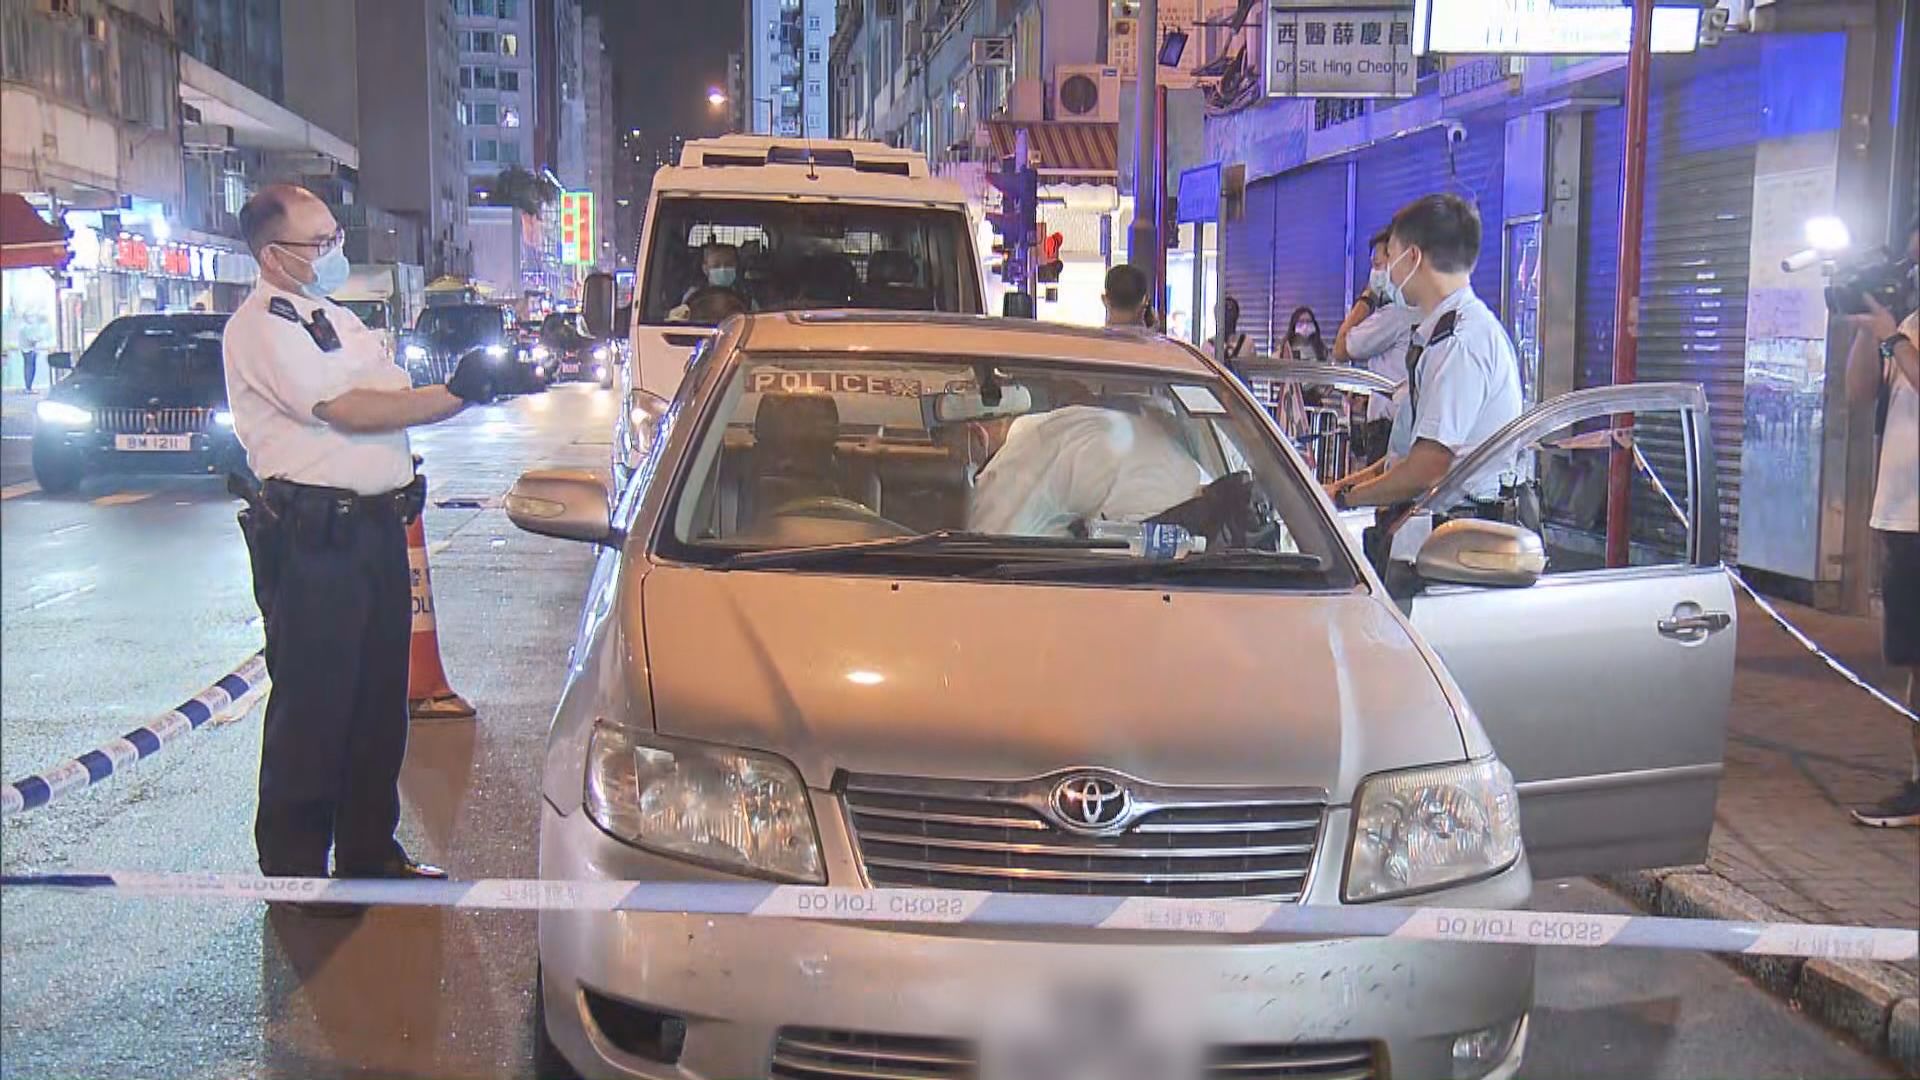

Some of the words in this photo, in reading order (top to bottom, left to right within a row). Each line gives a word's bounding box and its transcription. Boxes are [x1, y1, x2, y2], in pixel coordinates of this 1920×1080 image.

[1277, 22, 1409, 45] 西醫薛慶昌
[1299, 60, 1317, 73] Sit
[1323, 60, 1352, 77] Hing
[1357, 60, 1409, 77] Cheong
[754, 373, 885, 394] POLICE
